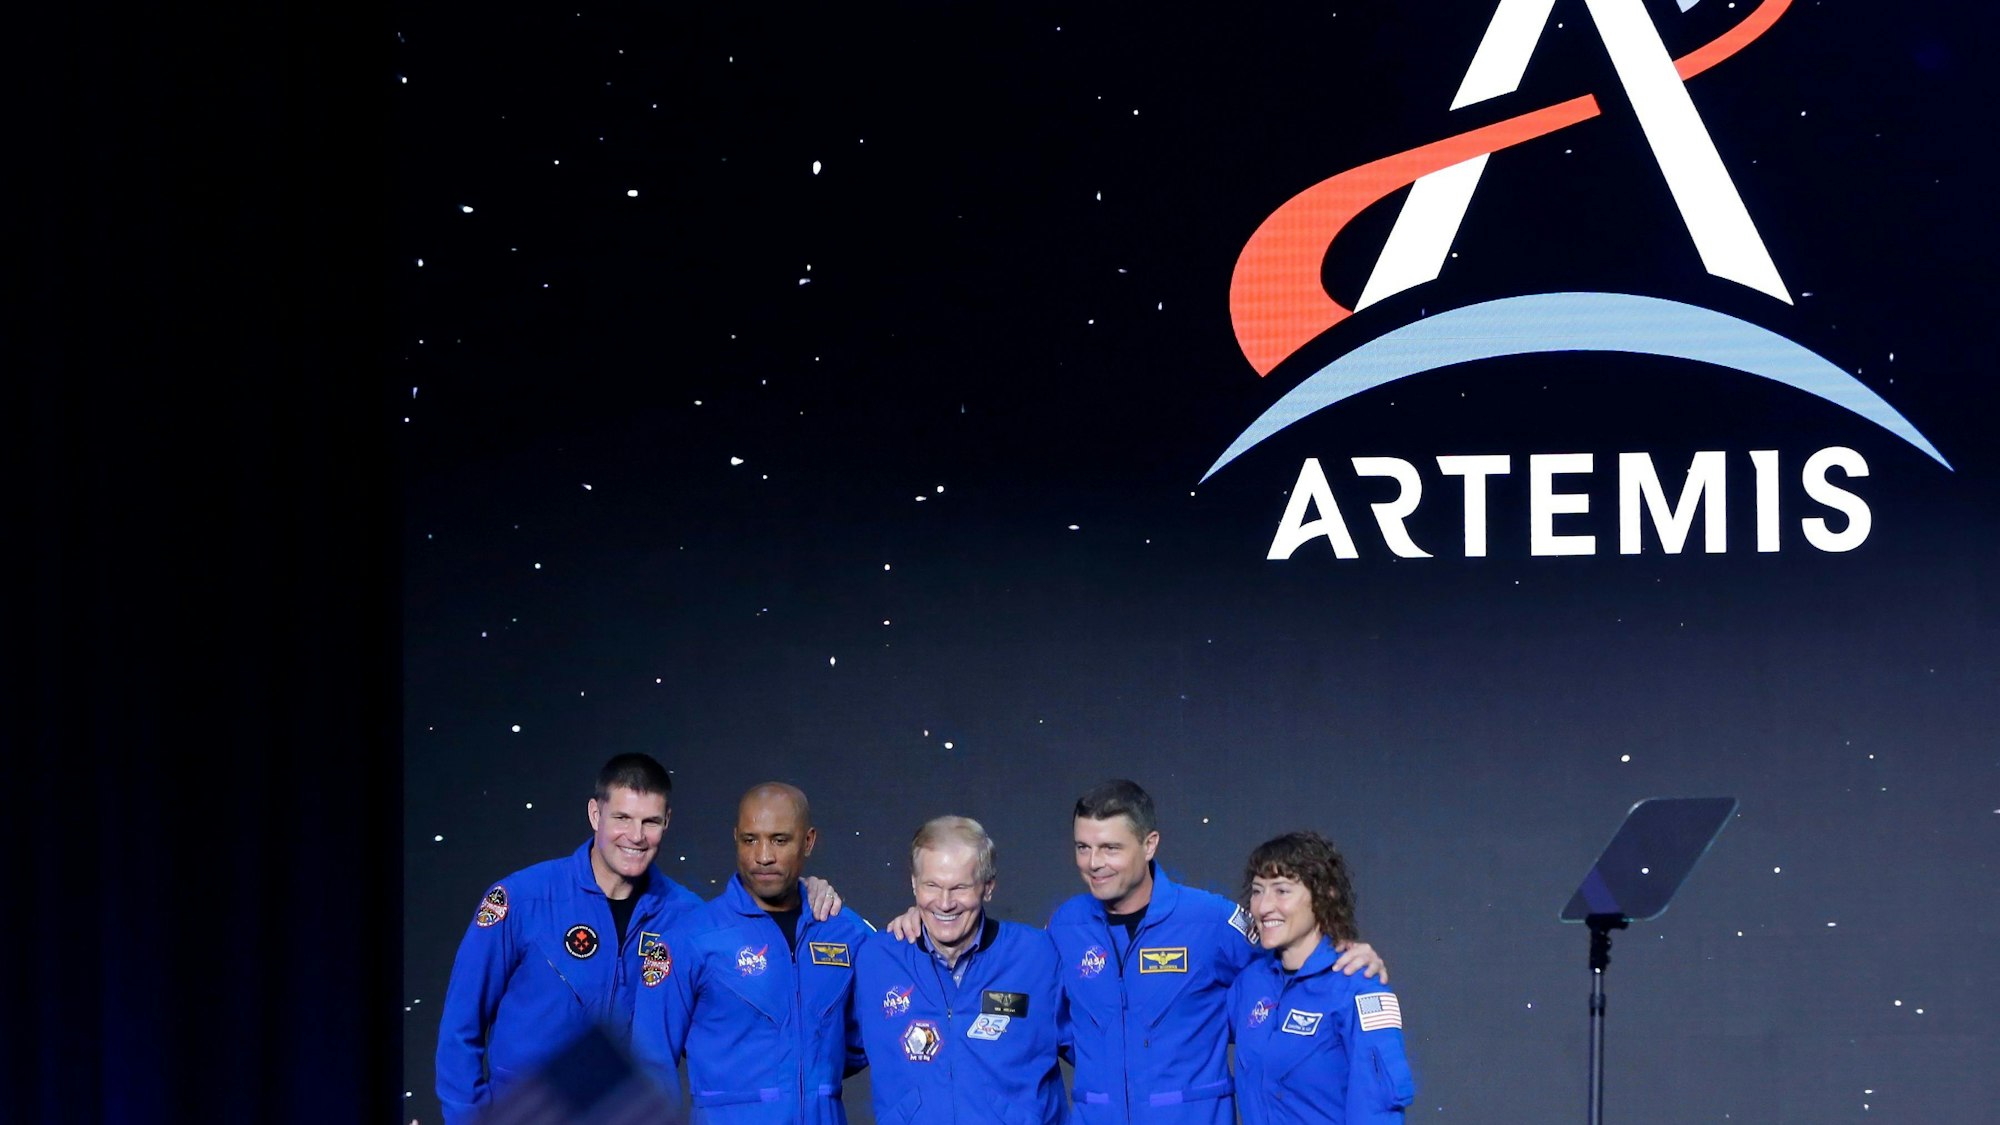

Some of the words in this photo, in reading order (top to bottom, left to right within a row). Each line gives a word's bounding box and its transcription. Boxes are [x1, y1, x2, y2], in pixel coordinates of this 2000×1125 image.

[1267, 447, 1872, 560] ARTEMIS
[738, 955, 767, 969] NASA
[883, 996, 910, 1009] NASA
